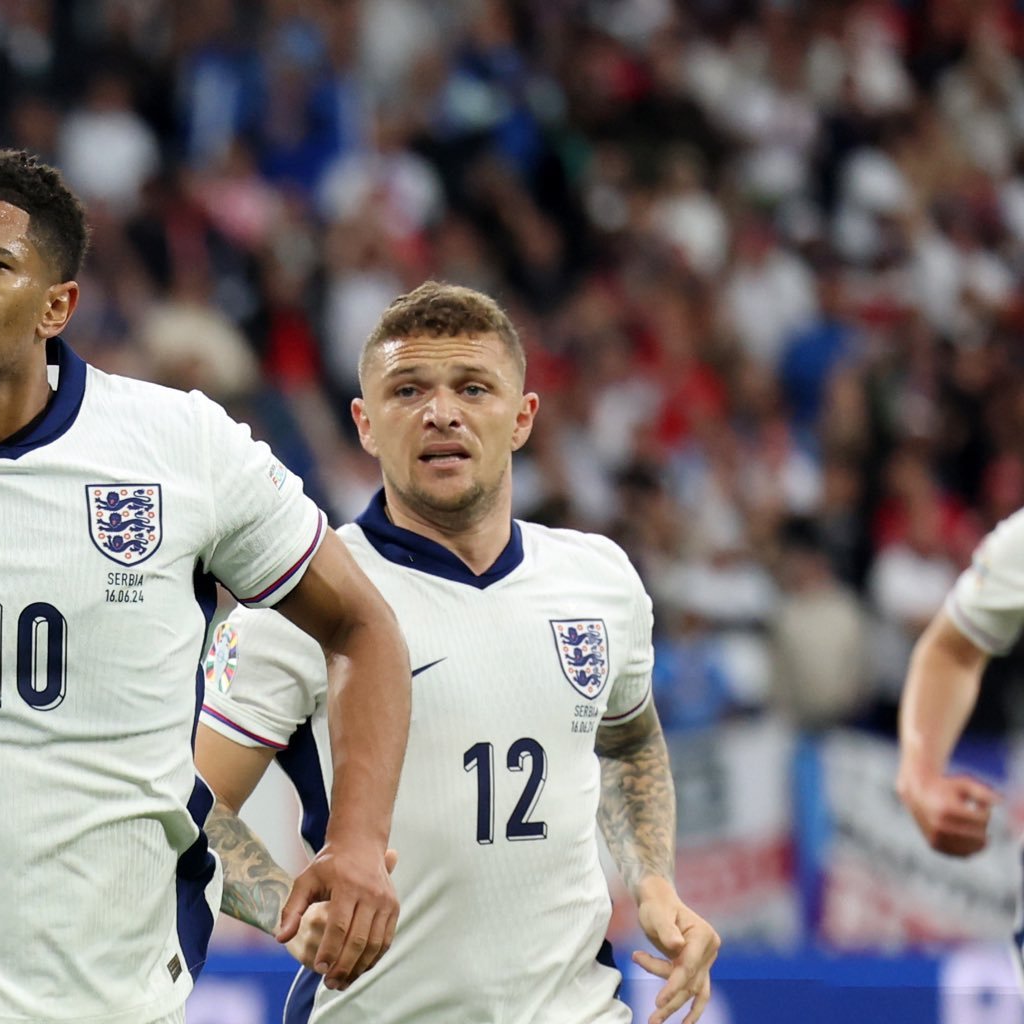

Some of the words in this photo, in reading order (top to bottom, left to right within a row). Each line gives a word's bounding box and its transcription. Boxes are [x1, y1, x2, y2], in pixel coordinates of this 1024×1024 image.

[107, 572, 144, 586] SERBIA
[105, 589, 144, 603] 16.06.24
[463, 737, 548, 845] 12
